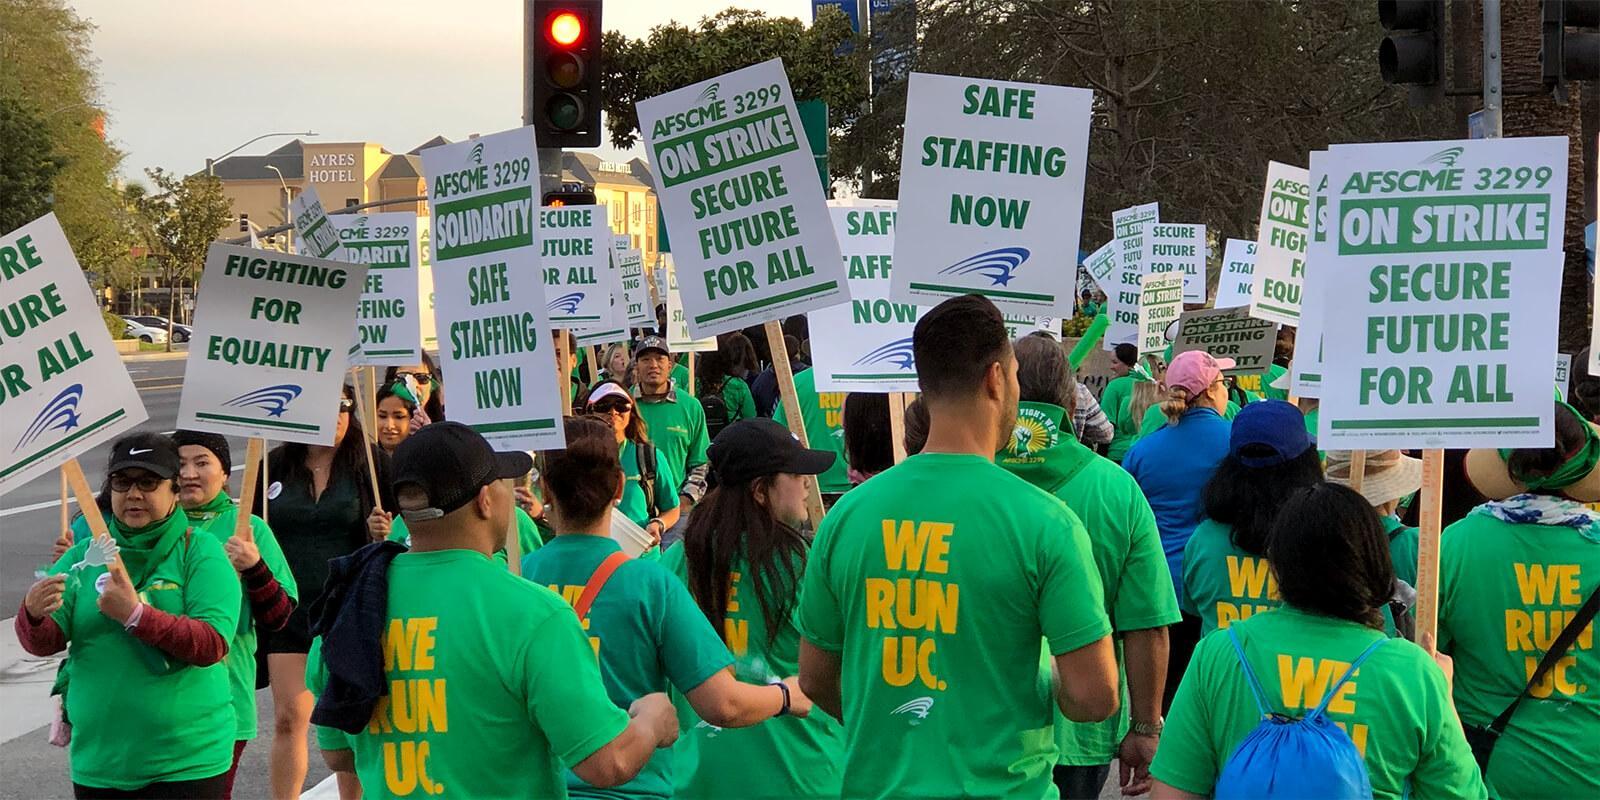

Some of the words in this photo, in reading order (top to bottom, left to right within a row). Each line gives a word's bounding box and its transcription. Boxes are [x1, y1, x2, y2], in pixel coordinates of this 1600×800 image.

[651, 99, 727, 140] AFSCME
[732, 83, 781, 114] 3299
[963, 84, 1036, 119] SAFE
[310, 154, 355, 166] AYRES
[659, 141, 700, 180] ON
[704, 113, 794, 167] STRIKE
[921, 136, 1066, 177] STAFFING
[310, 170, 355, 182] HOTEL
[434, 166, 488, 199] AFSCME
[493, 157, 530, 187] 3299
[1273, 178, 1310, 197] AFSC
[1341, 168, 1465, 195] AFSCME
[1474, 166, 1553, 190] 3299
[690, 165, 788, 219] SECURE
[540, 210, 592, 228] ECURE
[847, 210, 896, 236] SAF
[949, 193, 1030, 229] NOW
[1271, 197, 1297, 221] ON
[337, 227, 370, 240] CME
[375, 226, 409, 239] 3299
[437, 199, 531, 250] SOLIDARITY
[698, 205, 799, 260] FUTURE
[1153, 226, 1195, 238] SECURE
[1342, 207, 1399, 246] ON
[1412, 203, 1546, 244] STRIKE
[1123, 237, 1142, 250] SECU
[1124, 250, 1141, 263] FUTU
[1153, 244, 1195, 256] FUTURE
[224, 255, 348, 289] FIGHTING
[567, 267, 597, 284] ALL
[704, 260, 758, 301] FOR
[767, 245, 815, 285] ALL
[1121, 272, 1142, 286] SEC
[1151, 262, 1173, 273] FOR
[362, 274, 383, 293] FE
[469, 262, 510, 306] SAFE
[1144, 292, 1155, 304] ON
[1157, 289, 1181, 302] STRIKE
[1238, 283, 1252, 295] NO
[1369, 262, 1512, 303] SECURE
[251, 297, 302, 325] FOR
[853, 298, 917, 324] NOW
[1119, 291, 1141, 306] FUT
[1148, 306, 1174, 319] SECURE
[1116, 311, 1139, 325] FOR
[1184, 326, 1210, 335] ON
[1216, 319, 1271, 332] STRIKE
[1185, 314, 1237, 325] AFSCME
[450, 312, 536, 360] STAFFING
[1146, 336, 1160, 348] FOR
[1186, 331, 1265, 344] FIGHTING
[1366, 312, 1510, 354] FUTURE
[37, 331, 94, 382] ALL
[207, 335, 331, 372] EQUALITY
[1208, 344, 1240, 355] FOR
[475, 367, 522, 409] NOW
[1359, 366, 1433, 405] FOR
[1446, 364, 1514, 404] ALL
[819, 392, 846, 408] RU
[882, 519, 954, 574] WE
[1514, 562, 1581, 606] WE
[865, 578, 959, 634] RUN
[1505, 609, 1593, 651] RUN
[882, 636, 947, 691] UC.
[1277, 654, 1359, 714] WE
[383, 740, 444, 796] UC.
